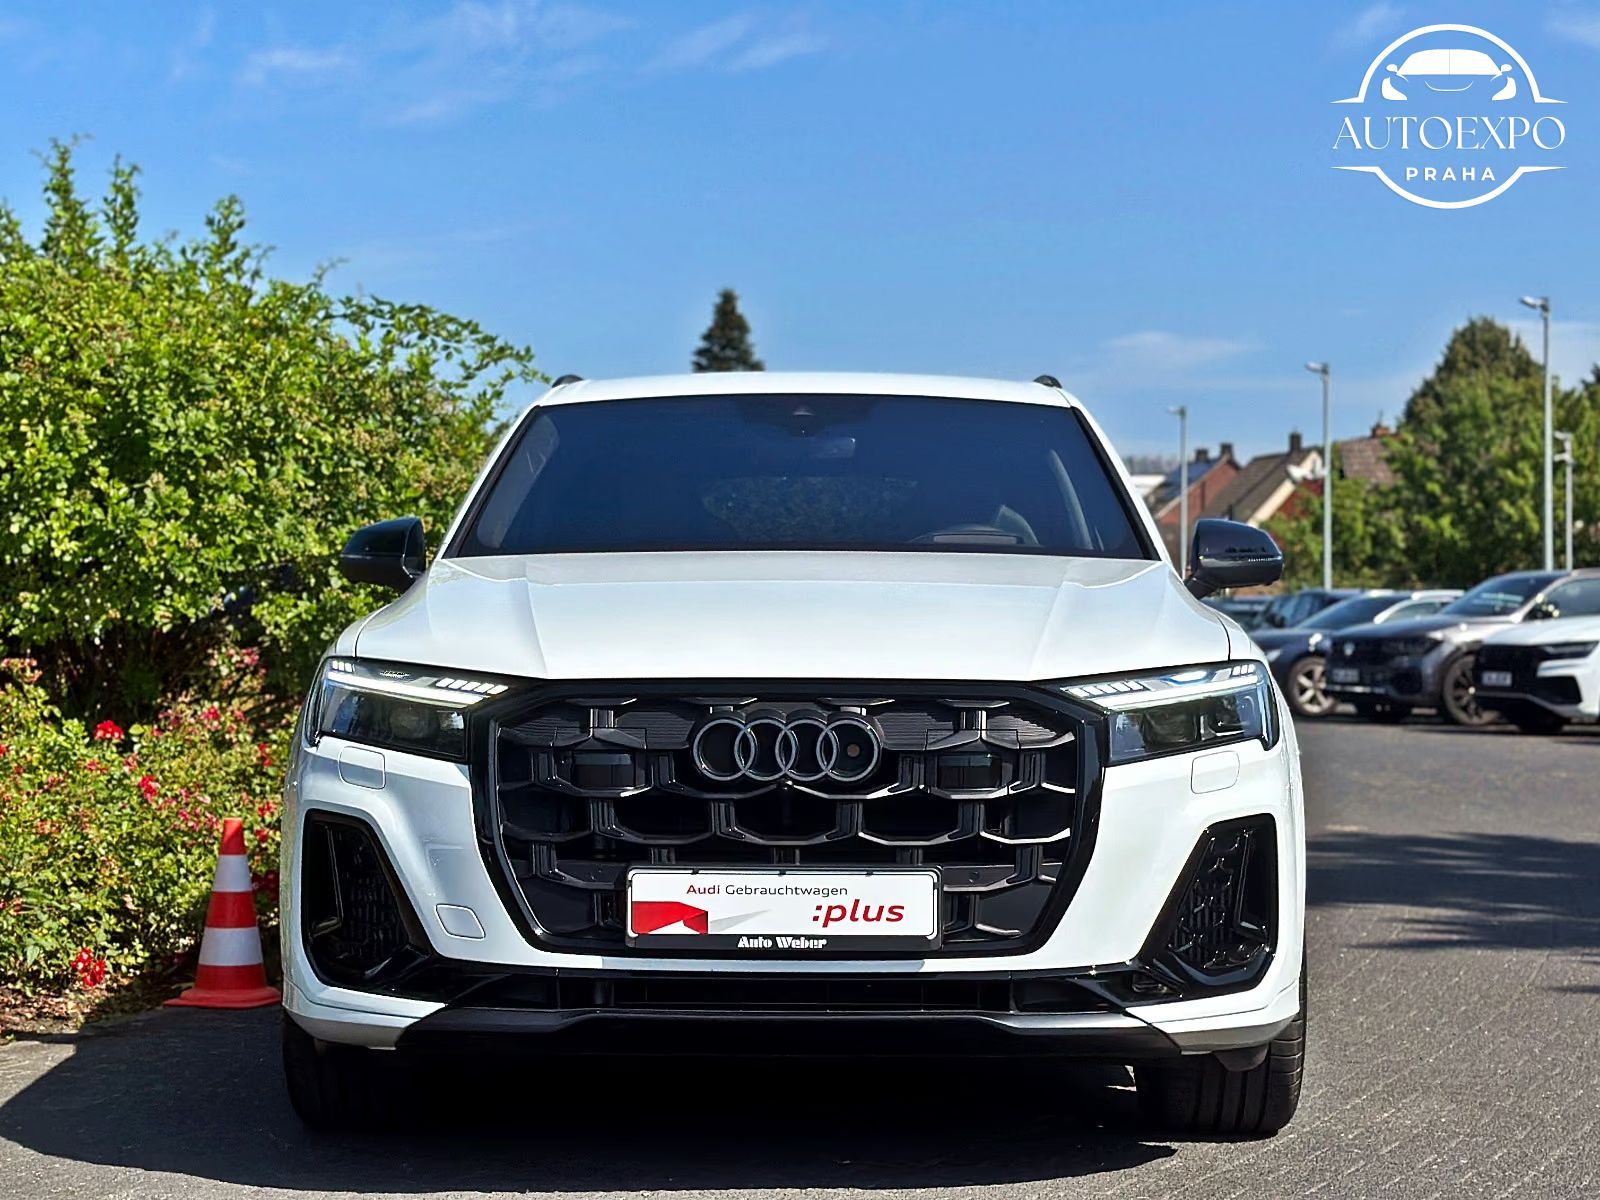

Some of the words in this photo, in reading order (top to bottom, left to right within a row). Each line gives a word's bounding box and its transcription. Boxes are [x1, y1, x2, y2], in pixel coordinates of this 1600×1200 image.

[686, 884, 720, 895] Audi
[725, 884, 848, 898] Gebrauchtwagen
[812, 899, 905, 928] :plus
[737, 936, 773, 949] Auto
[776, 936, 828, 949] Weber
